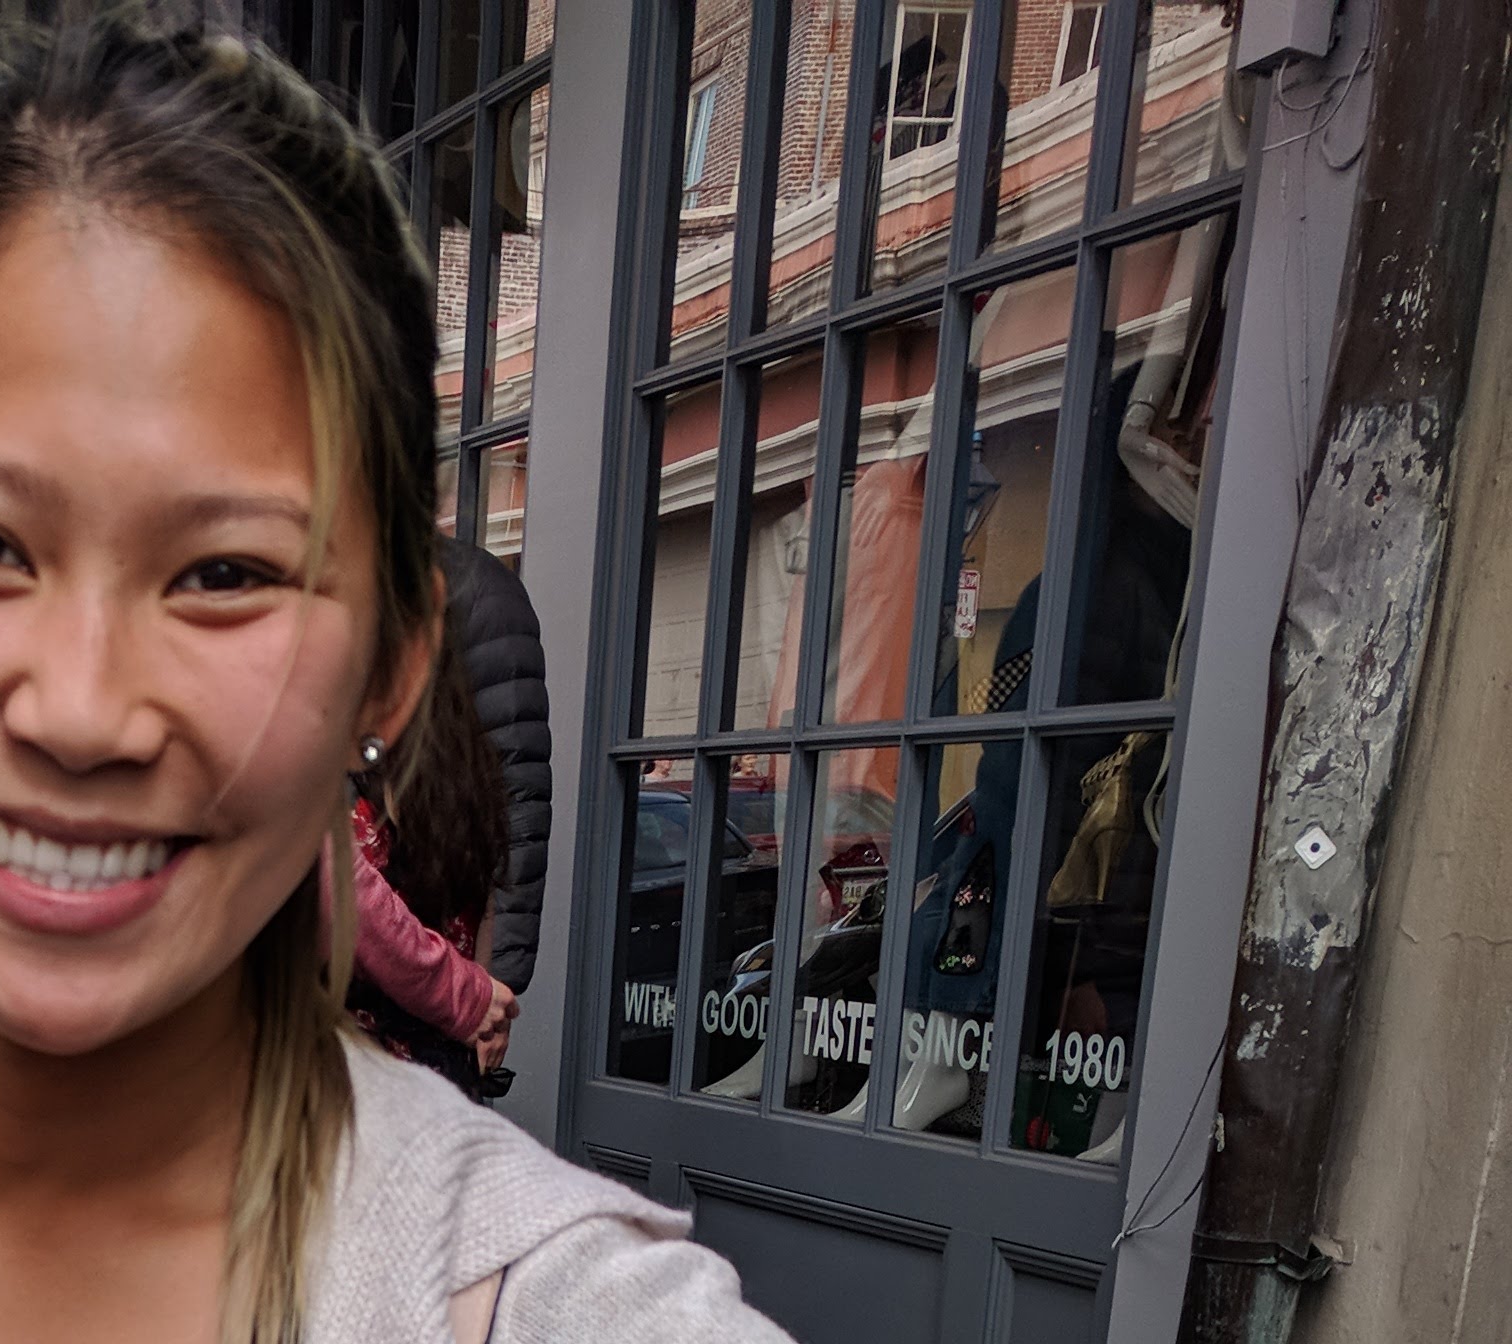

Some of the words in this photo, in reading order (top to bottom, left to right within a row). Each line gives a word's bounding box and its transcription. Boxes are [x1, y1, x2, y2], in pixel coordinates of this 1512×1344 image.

[803, 996, 876, 1065] TASTE
[905, 1012, 994, 1073] SINCE
[1045, 1028, 1126, 1091] 1980
